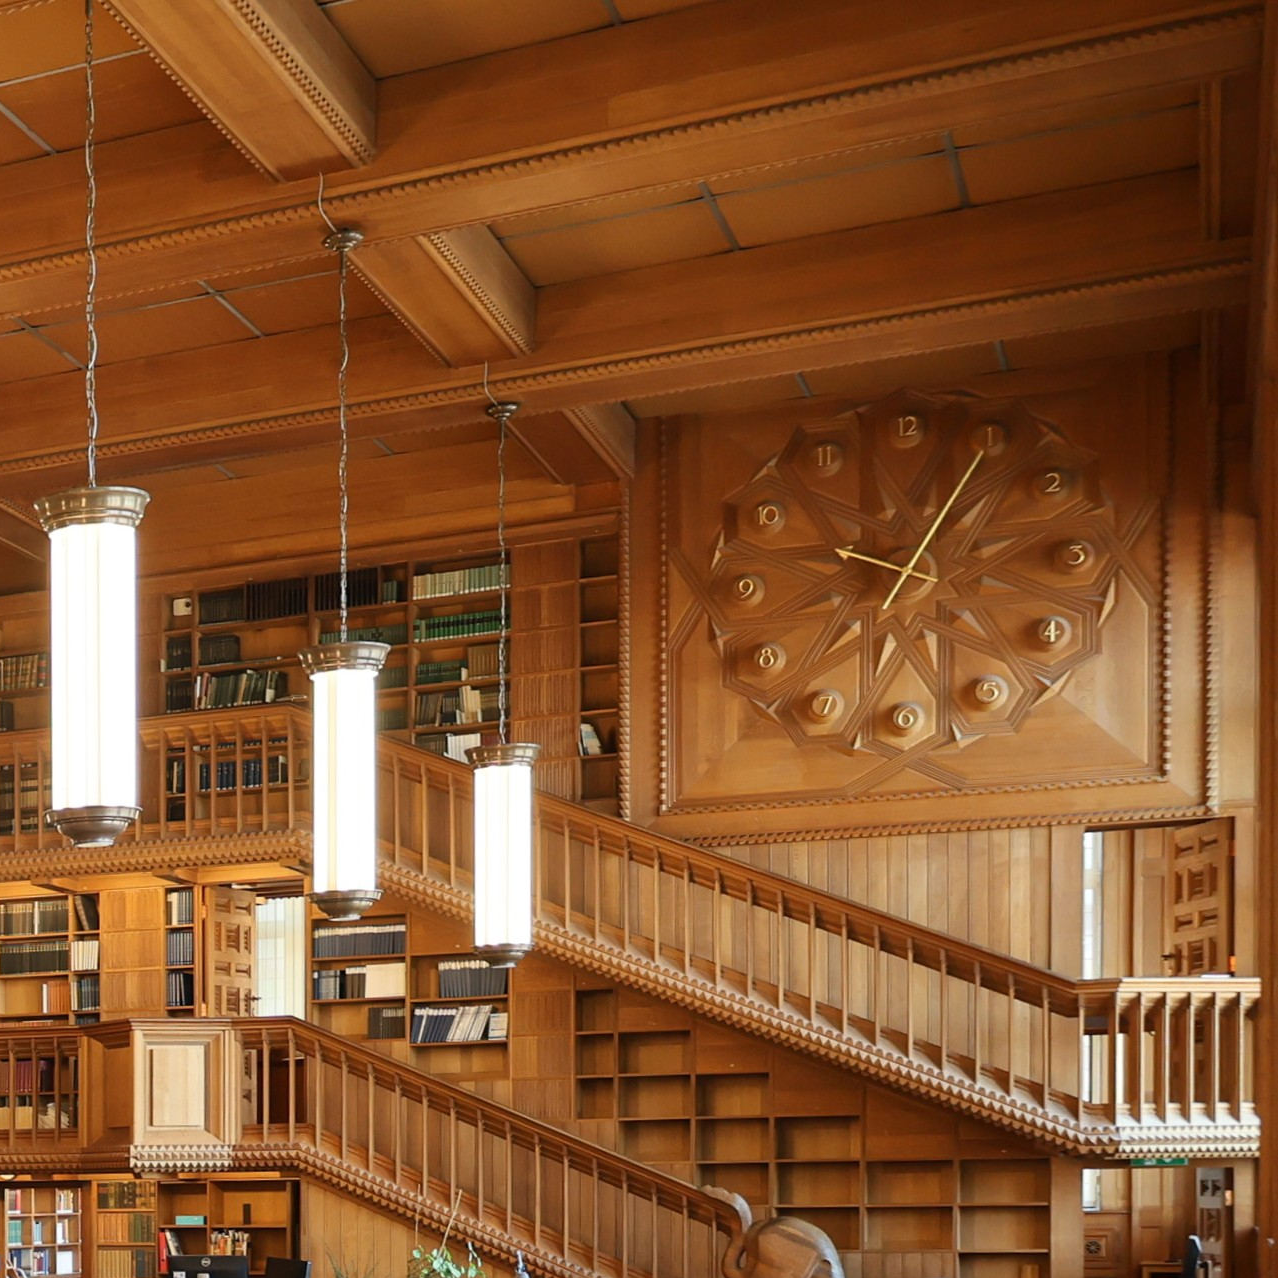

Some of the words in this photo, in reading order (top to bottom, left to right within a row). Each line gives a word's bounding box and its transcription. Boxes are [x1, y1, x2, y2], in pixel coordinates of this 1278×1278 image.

[898, 416, 917, 437] 12
[986, 426, 993, 447] 1
[817, 446, 832, 467] 11
[1044, 472, 1061, 493] 2
[758, 505, 779, 526] 10
[1068, 545, 1085, 565] 3
[738, 578, 754, 599] 9
[1044, 620, 1060, 643] 4
[759, 647, 775, 668] 8
[982, 682, 999, 702] 5
[819, 695, 834, 715] 7
[898, 707, 914, 727] 6
